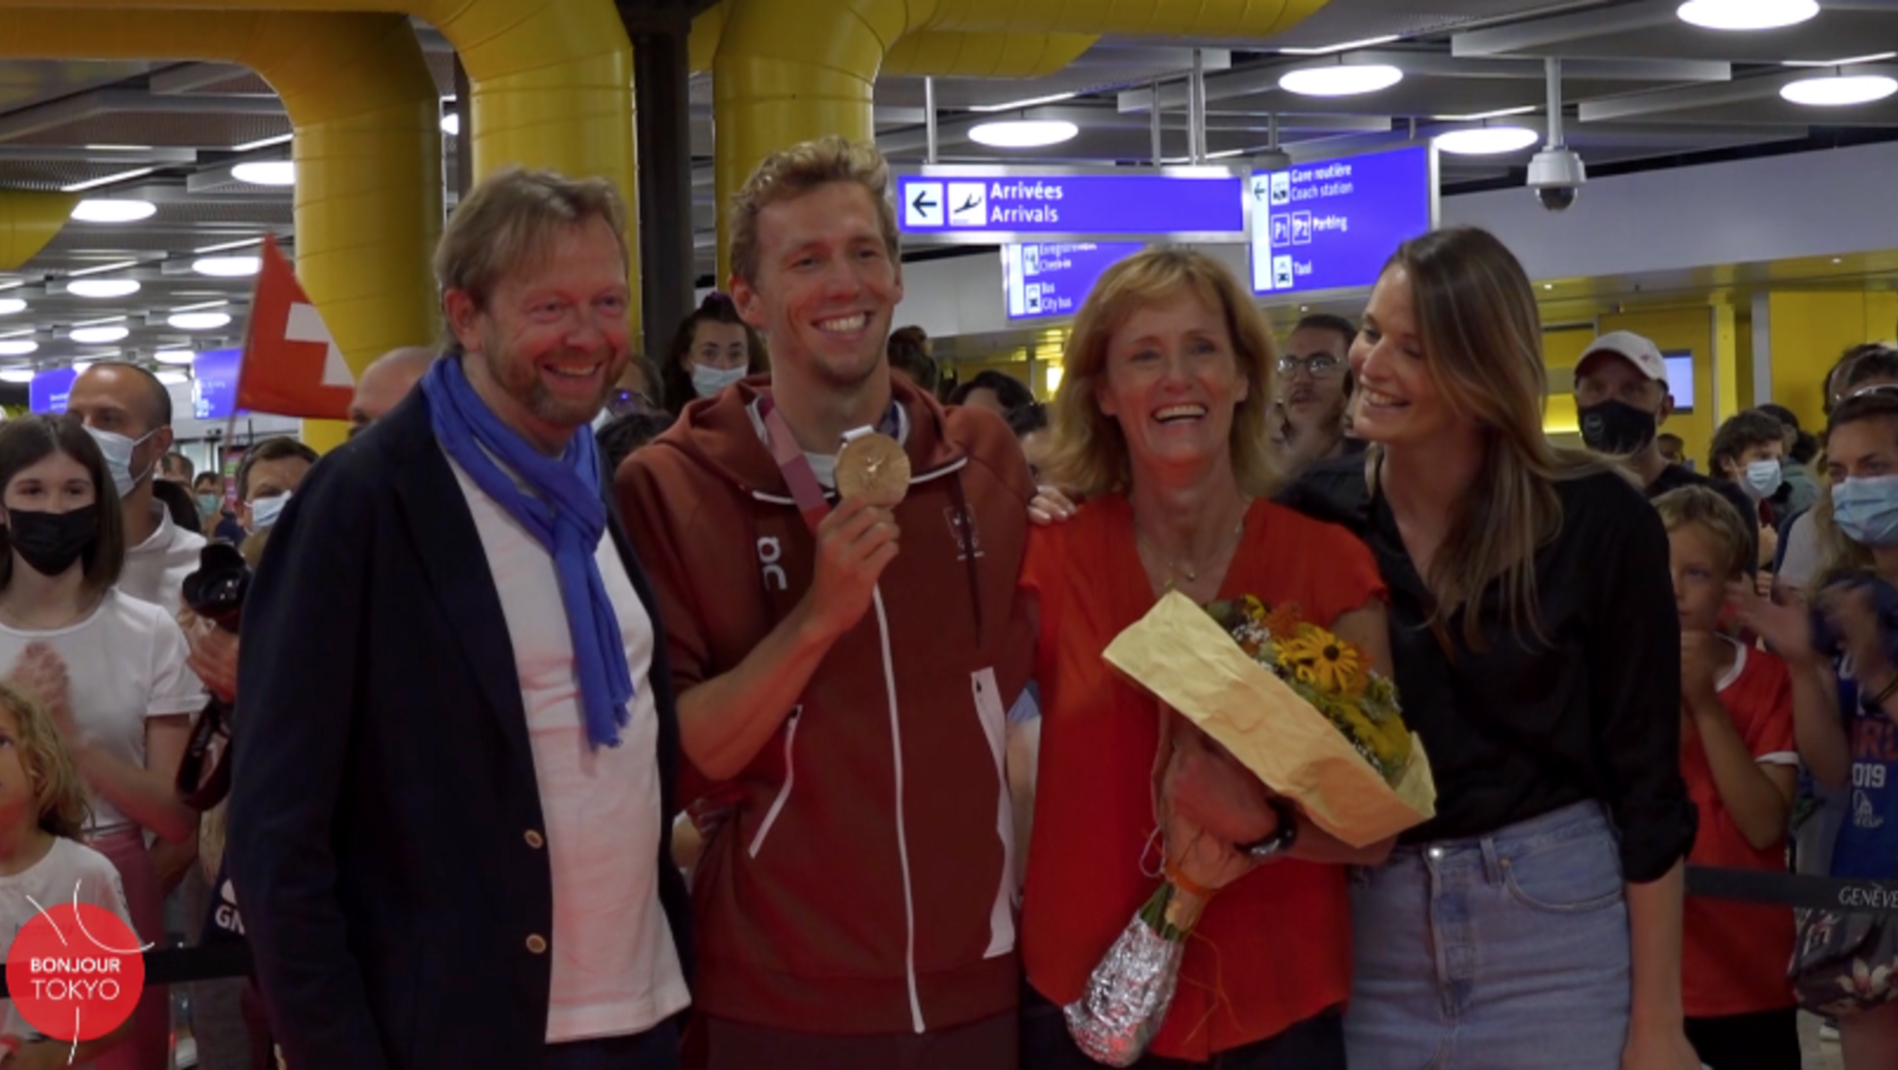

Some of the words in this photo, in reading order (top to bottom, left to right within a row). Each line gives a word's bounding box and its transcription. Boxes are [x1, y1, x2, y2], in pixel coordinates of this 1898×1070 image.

[1292, 168, 1312, 184] Gare
[990, 180, 1064, 200] Arrivées
[1292, 184, 1319, 201] Coach
[1320, 181, 1355, 198] station
[990, 204, 1059, 222] Arrivals
[1313, 215, 1347, 232] Parking
[1041, 281, 1056, 295] Bus
[1042, 297, 1057, 313] City
[1853, 763, 1886, 787] 019
